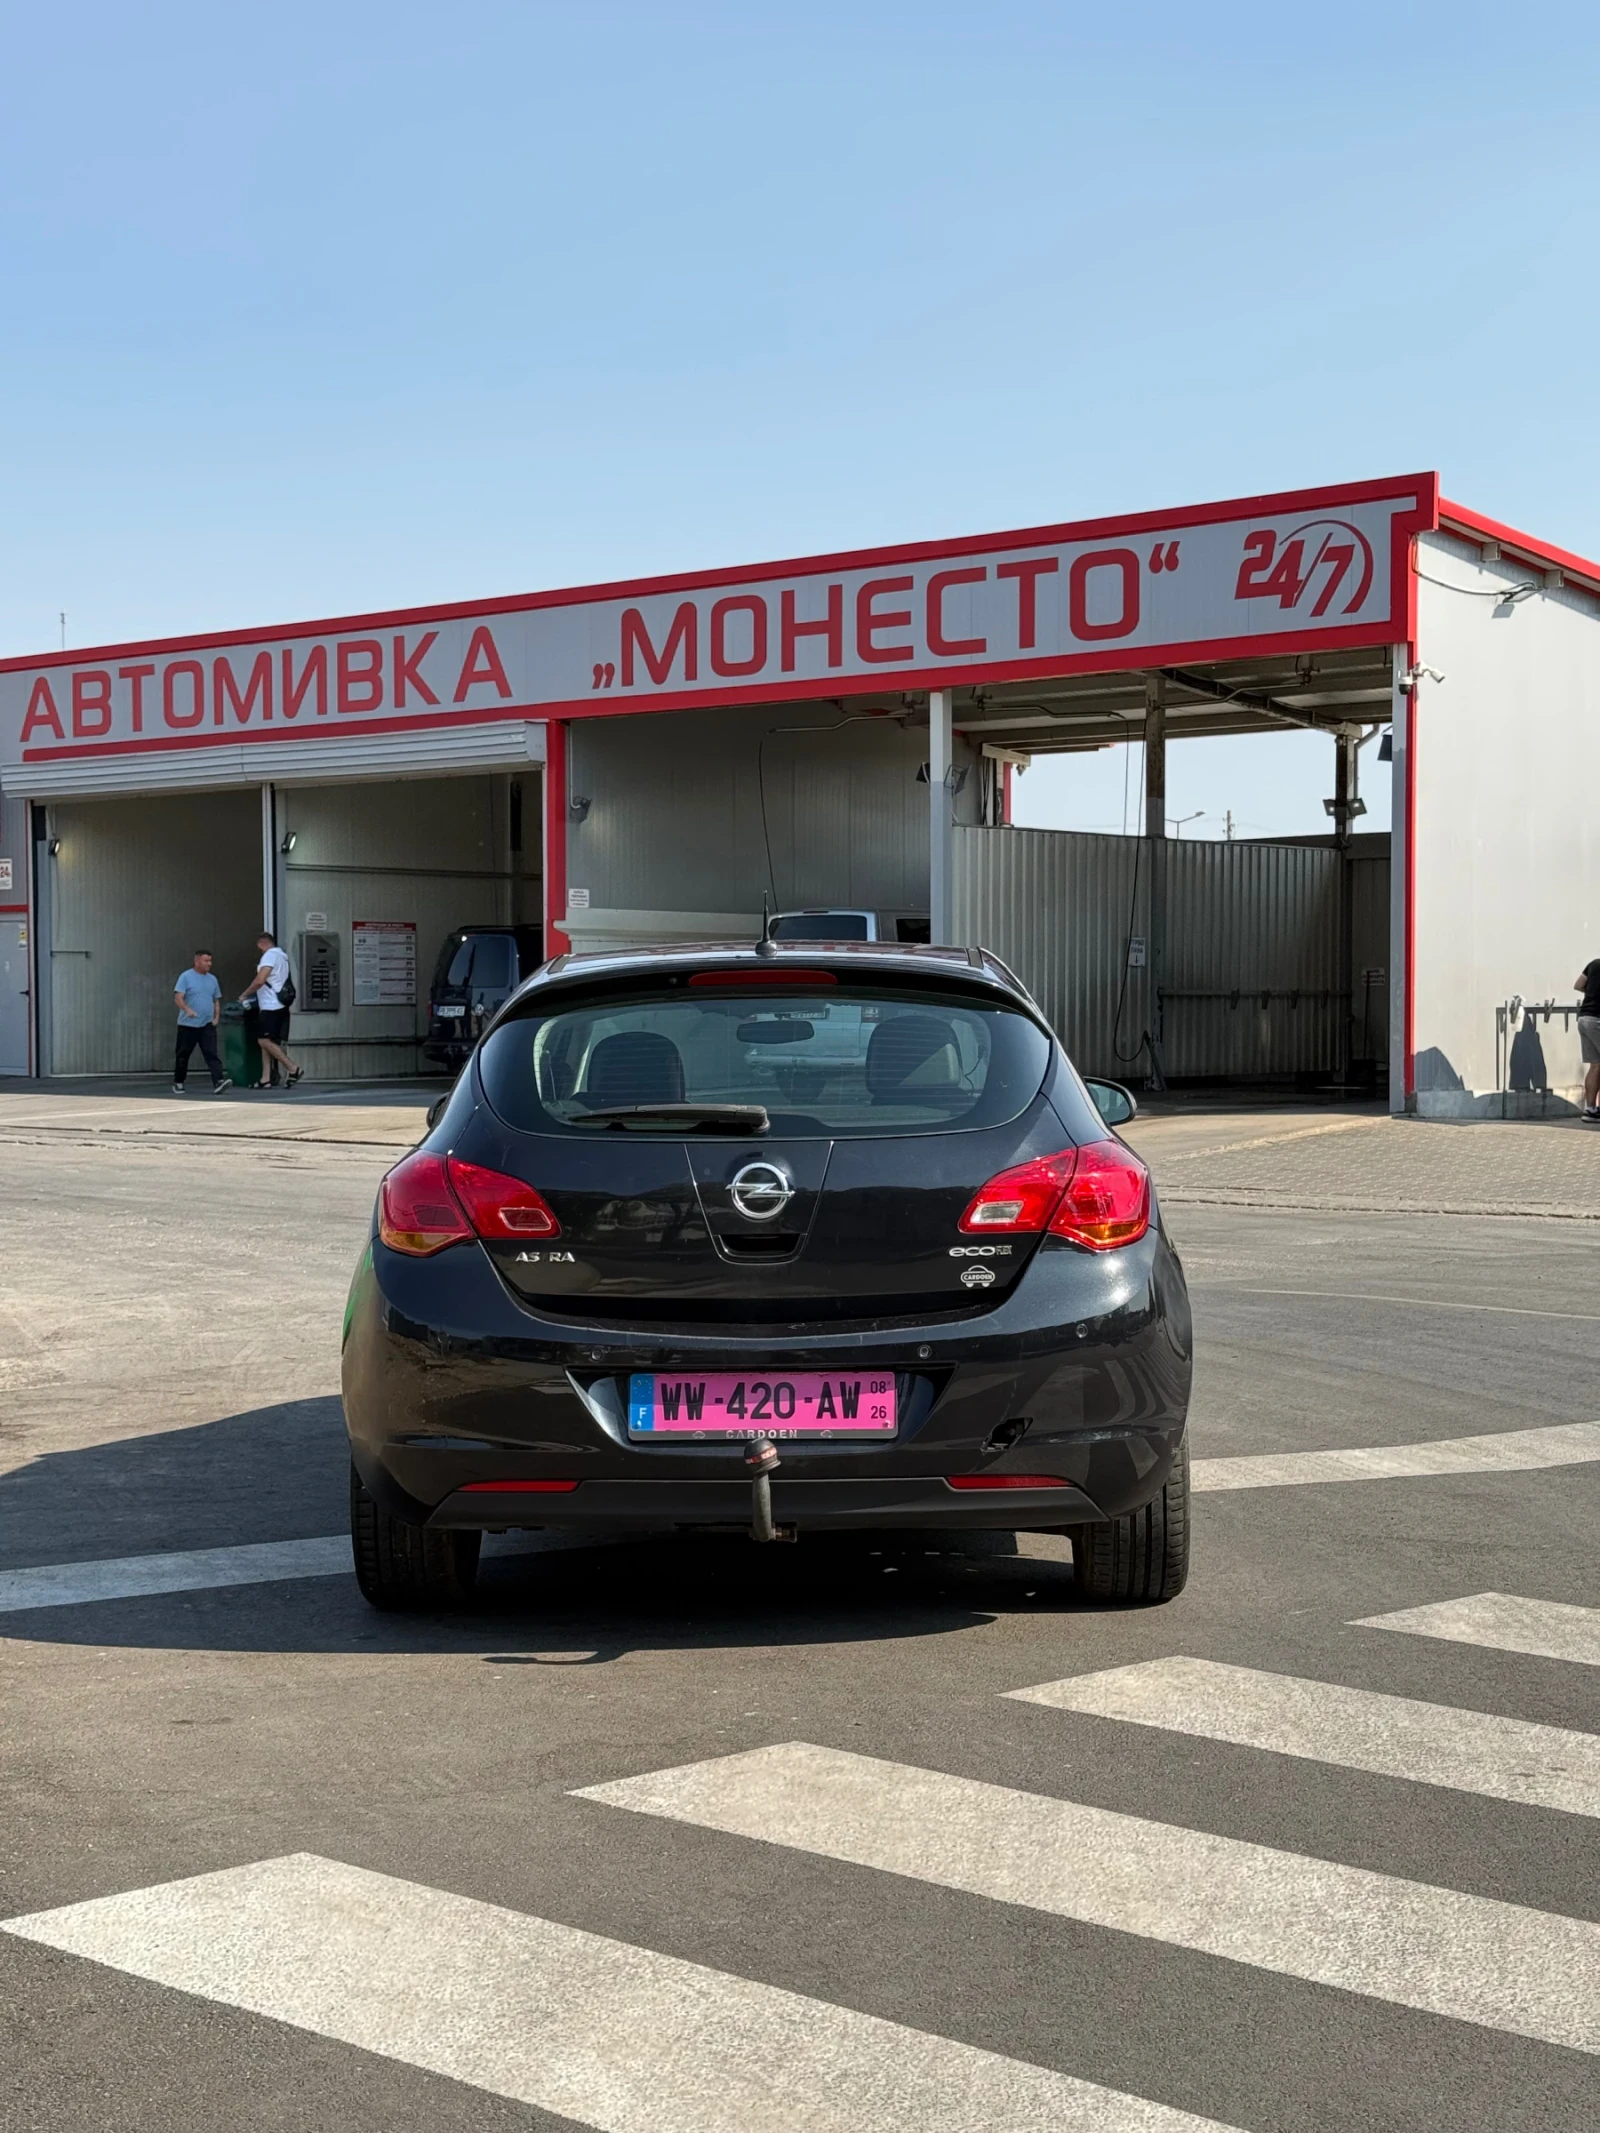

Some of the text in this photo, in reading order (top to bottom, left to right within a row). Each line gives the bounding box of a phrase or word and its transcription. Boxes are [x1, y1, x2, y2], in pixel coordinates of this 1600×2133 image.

[1234, 528, 1356, 618] 24/7
[20, 625, 513, 742] АВТОМИВКА
[870, 1380, 886, 1394] 08
[639, 1407, 647, 1419] F
[870, 1405, 887, 1419] 26
[726, 1429, 797, 1439] CARDOEN
